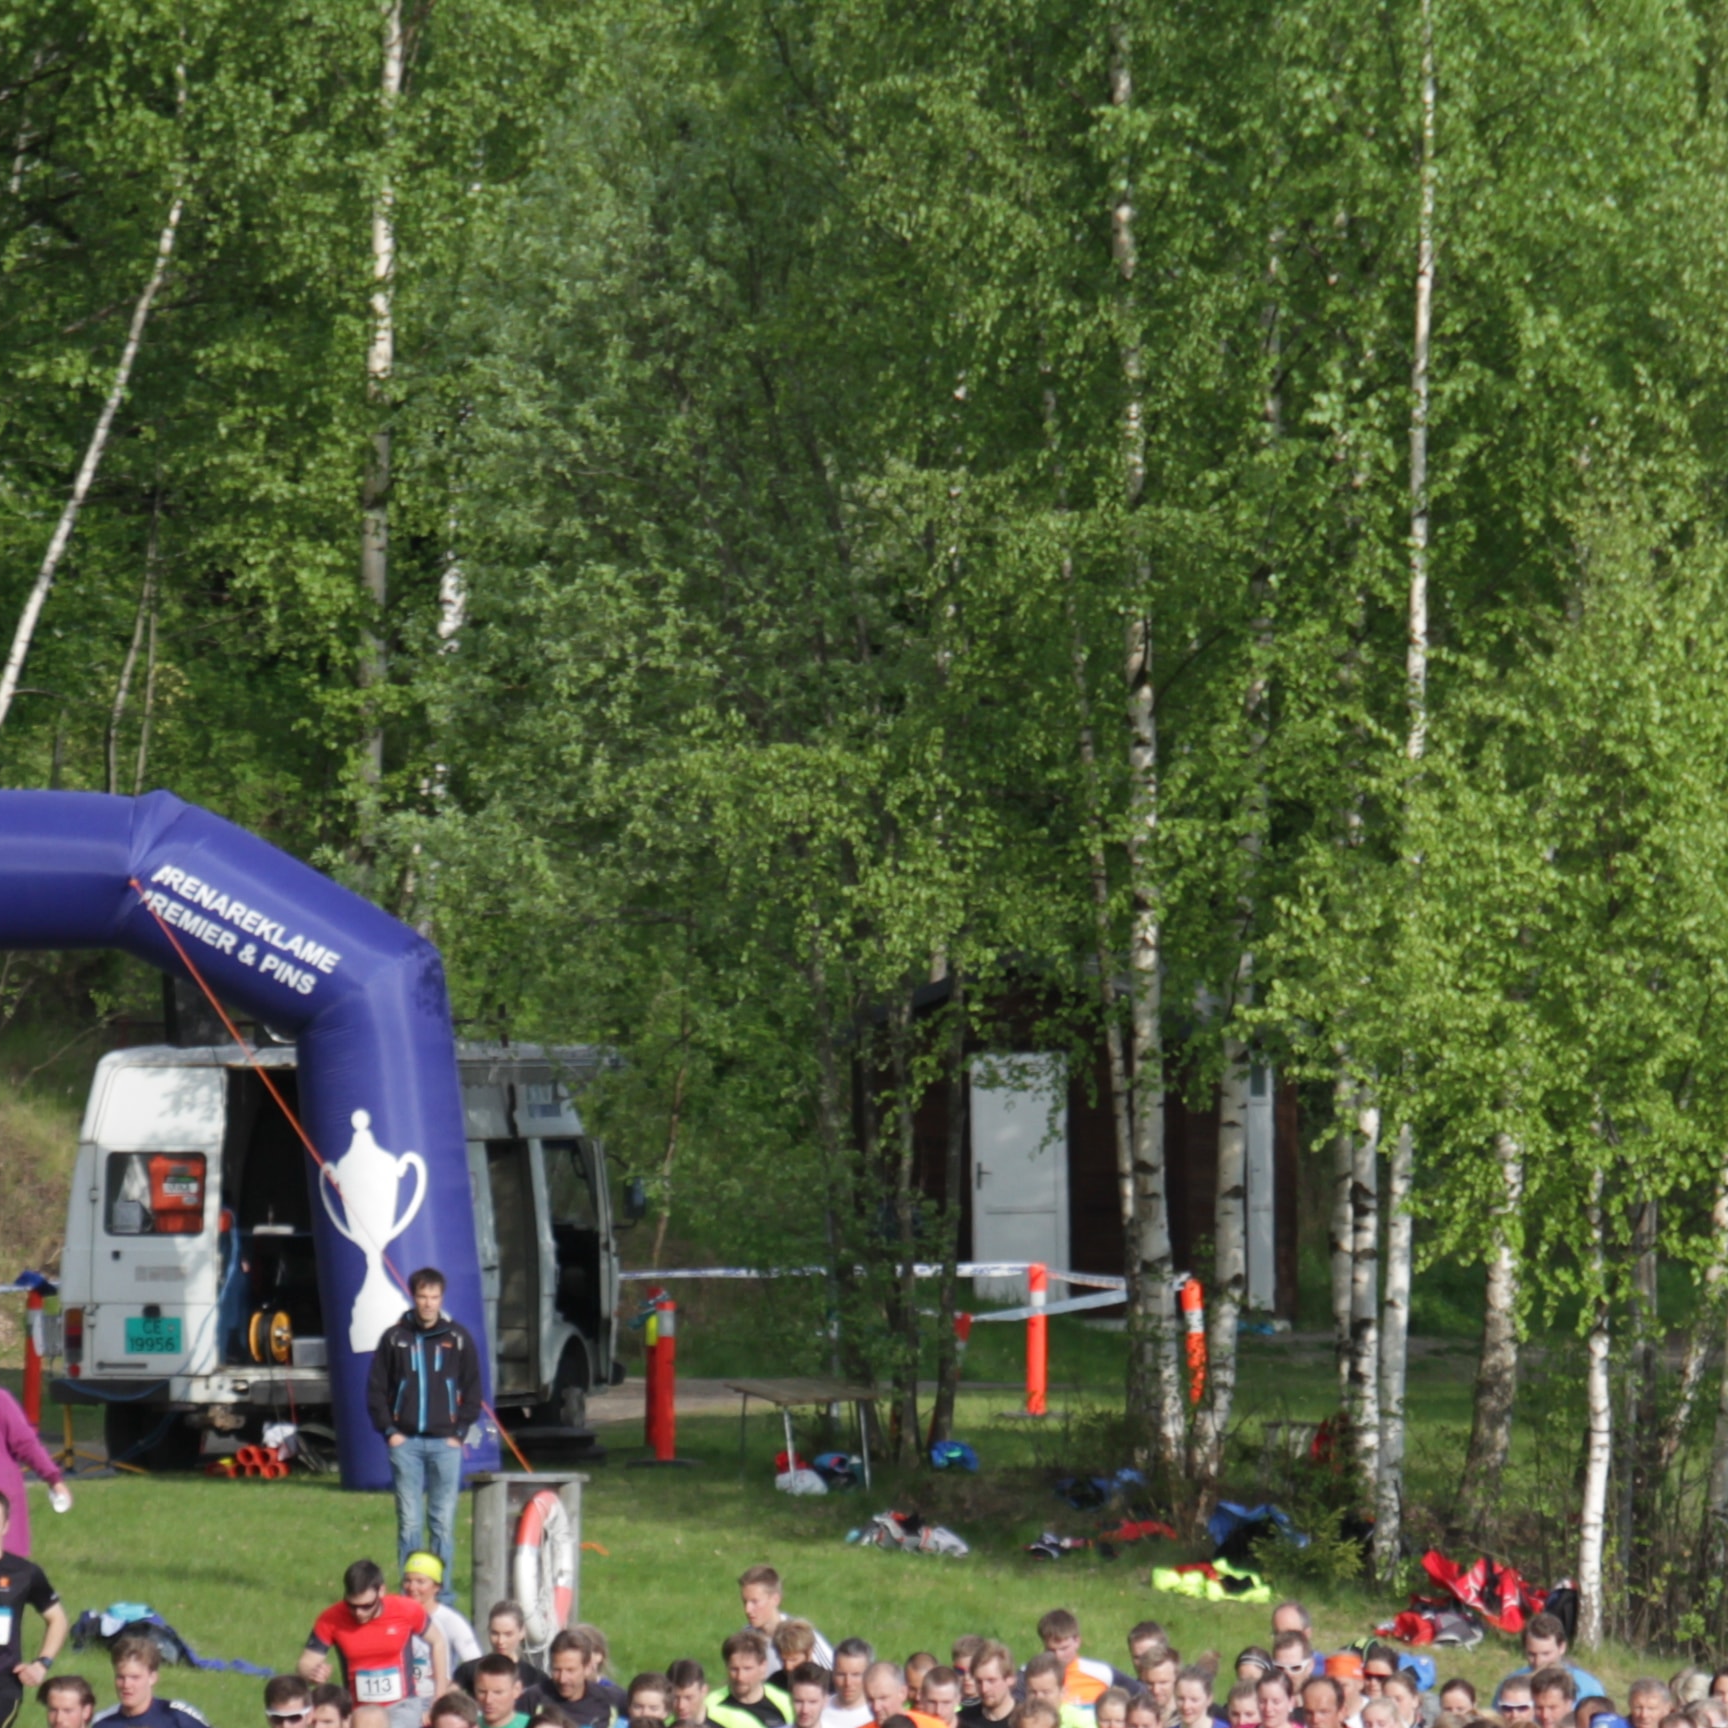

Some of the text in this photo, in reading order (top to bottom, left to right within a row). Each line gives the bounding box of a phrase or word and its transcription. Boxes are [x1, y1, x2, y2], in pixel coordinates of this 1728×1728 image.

[151, 864, 342, 974] ARENAREKLAME
[236, 942, 259, 966] &
[258, 953, 318, 996] PINS
[364, 1677, 393, 1695] 113
